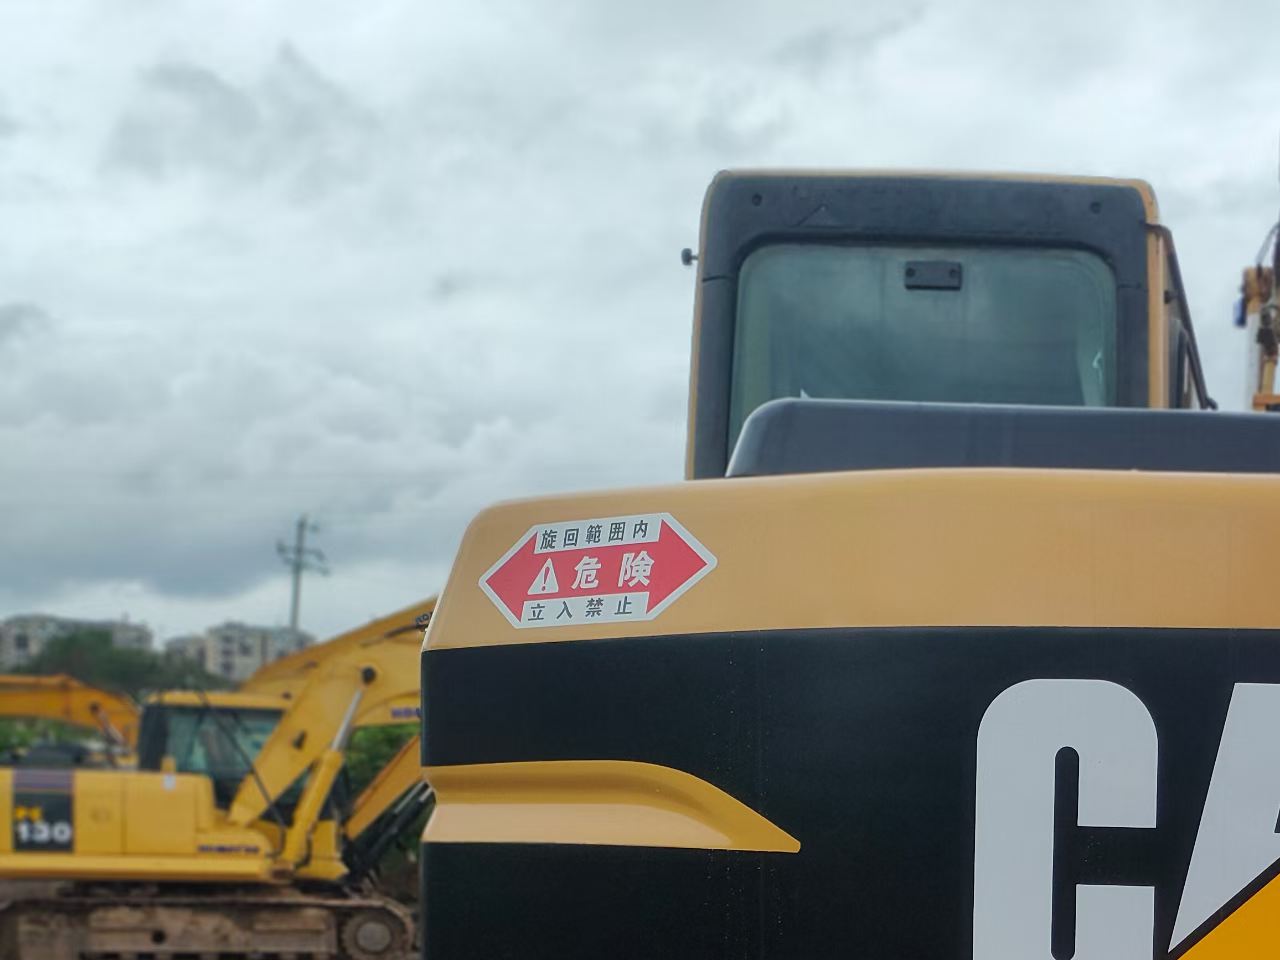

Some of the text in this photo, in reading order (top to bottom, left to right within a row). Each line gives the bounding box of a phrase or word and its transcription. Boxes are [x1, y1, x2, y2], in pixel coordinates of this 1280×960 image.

[540, 520, 649, 550] 旋回範囲内
[571, 551, 655, 590] 危険
[528, 596, 632, 621] 立入禁止
